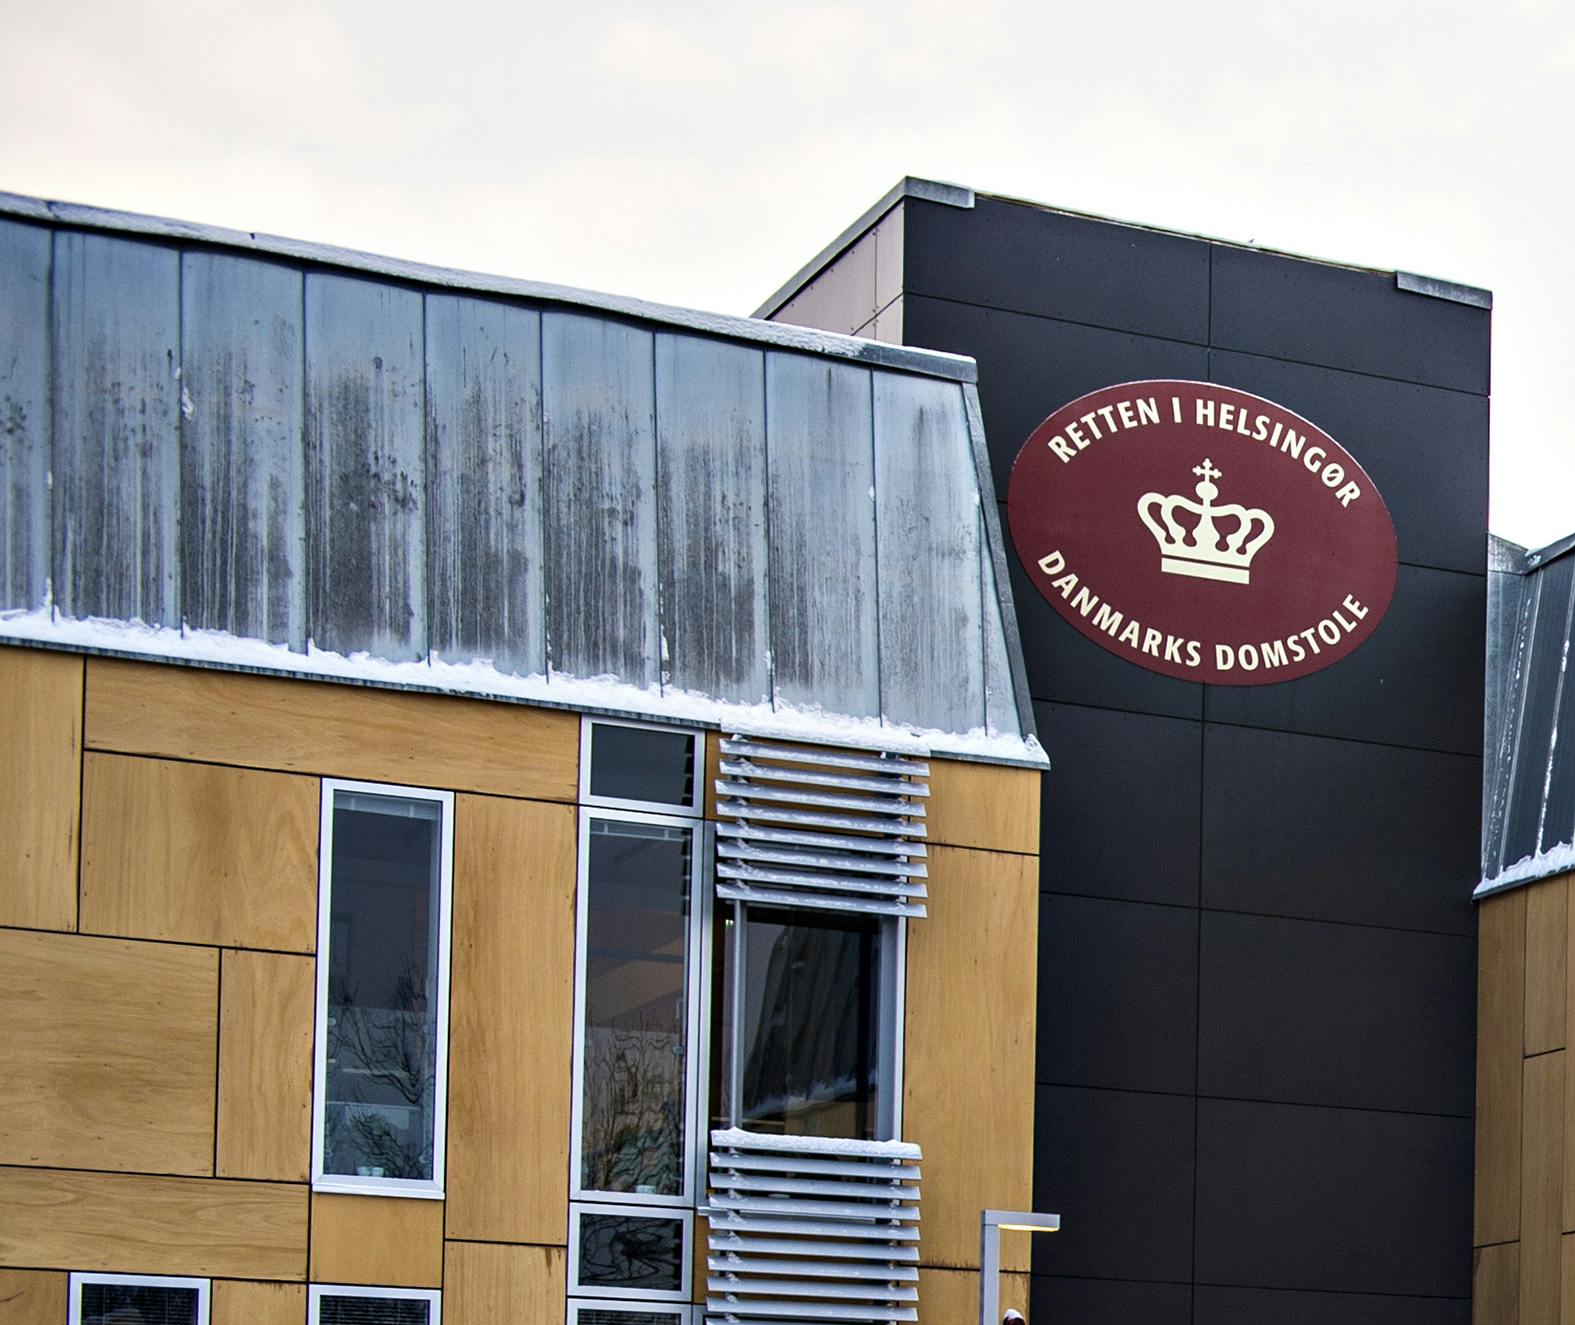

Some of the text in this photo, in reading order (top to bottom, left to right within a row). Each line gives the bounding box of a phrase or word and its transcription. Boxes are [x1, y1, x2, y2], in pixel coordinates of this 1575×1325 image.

[1047, 396, 1362, 509] RETTEN I HELSINGØR
[1037, 549, 1369, 671] DANMARKS DOMSTOLE
